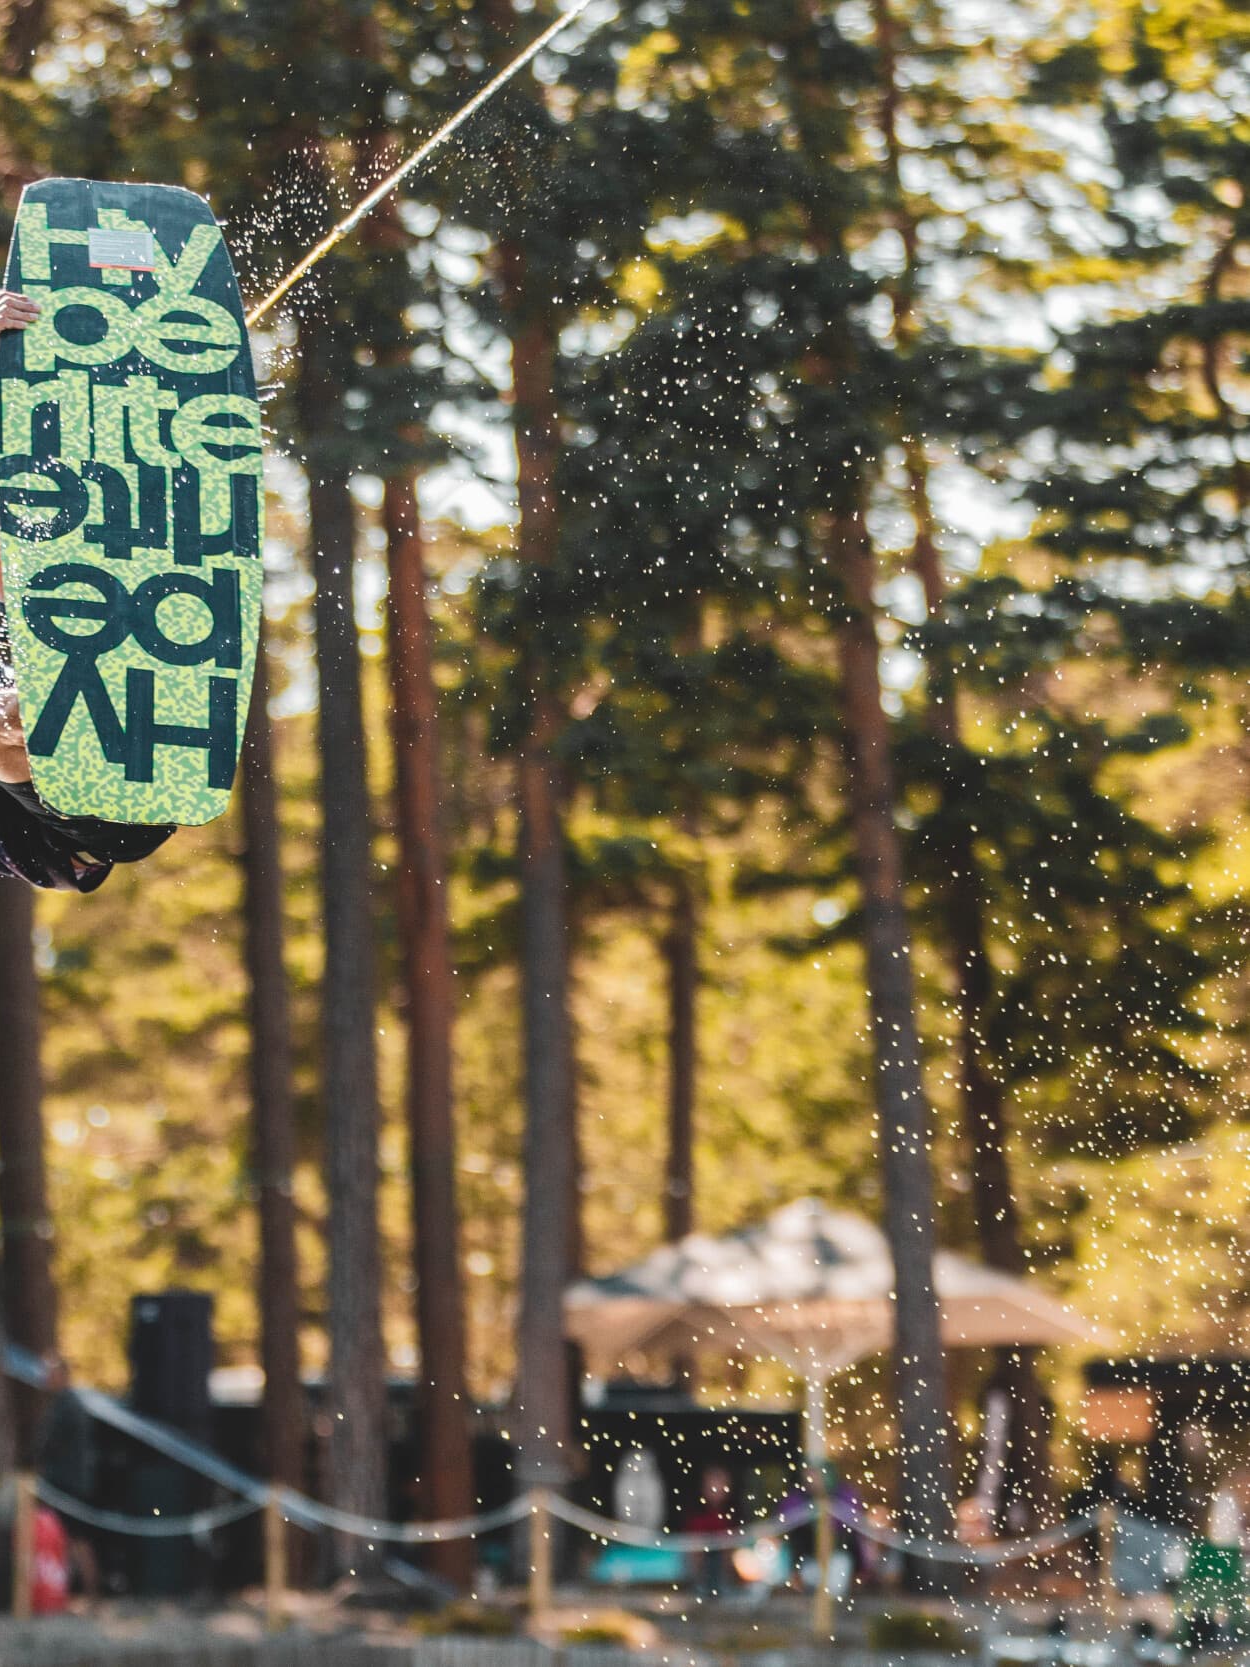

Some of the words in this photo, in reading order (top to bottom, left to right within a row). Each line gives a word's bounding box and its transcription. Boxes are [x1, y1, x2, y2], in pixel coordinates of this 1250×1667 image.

[22, 284, 242, 373] pe
[23, 562, 242, 669] pe
[28, 655, 237, 790] Hy
